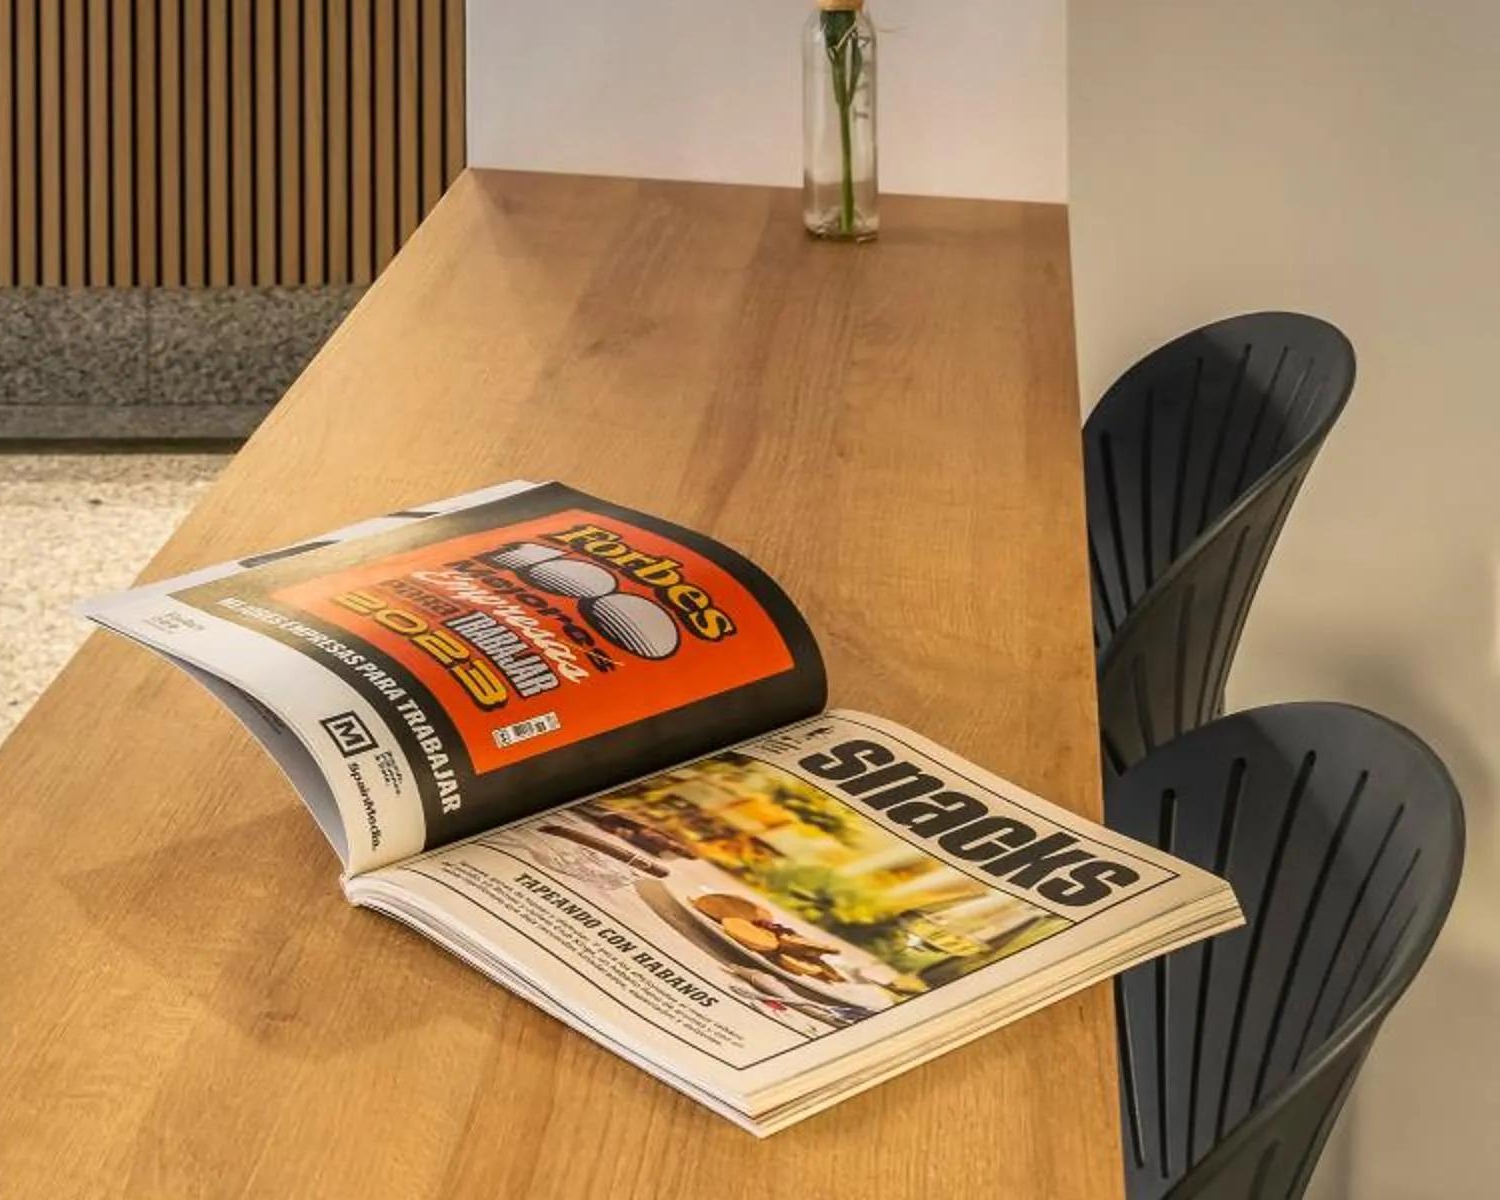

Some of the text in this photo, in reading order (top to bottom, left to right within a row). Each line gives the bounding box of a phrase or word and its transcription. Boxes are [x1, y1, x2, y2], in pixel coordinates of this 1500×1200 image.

[412, 571, 590, 684] Empresas
[478, 541, 681, 660] 100
[549, 524, 737, 642] Forbes
[336, 591, 509, 709] 2023
[446, 611, 560, 698] TRABAJAR
[355, 662, 407, 701] PARA
[396, 698, 462, 814] TRABAJAR
[797, 739, 1141, 907] snacks
[513, 871, 719, 1009] TAPEANDO CON HABANOS
